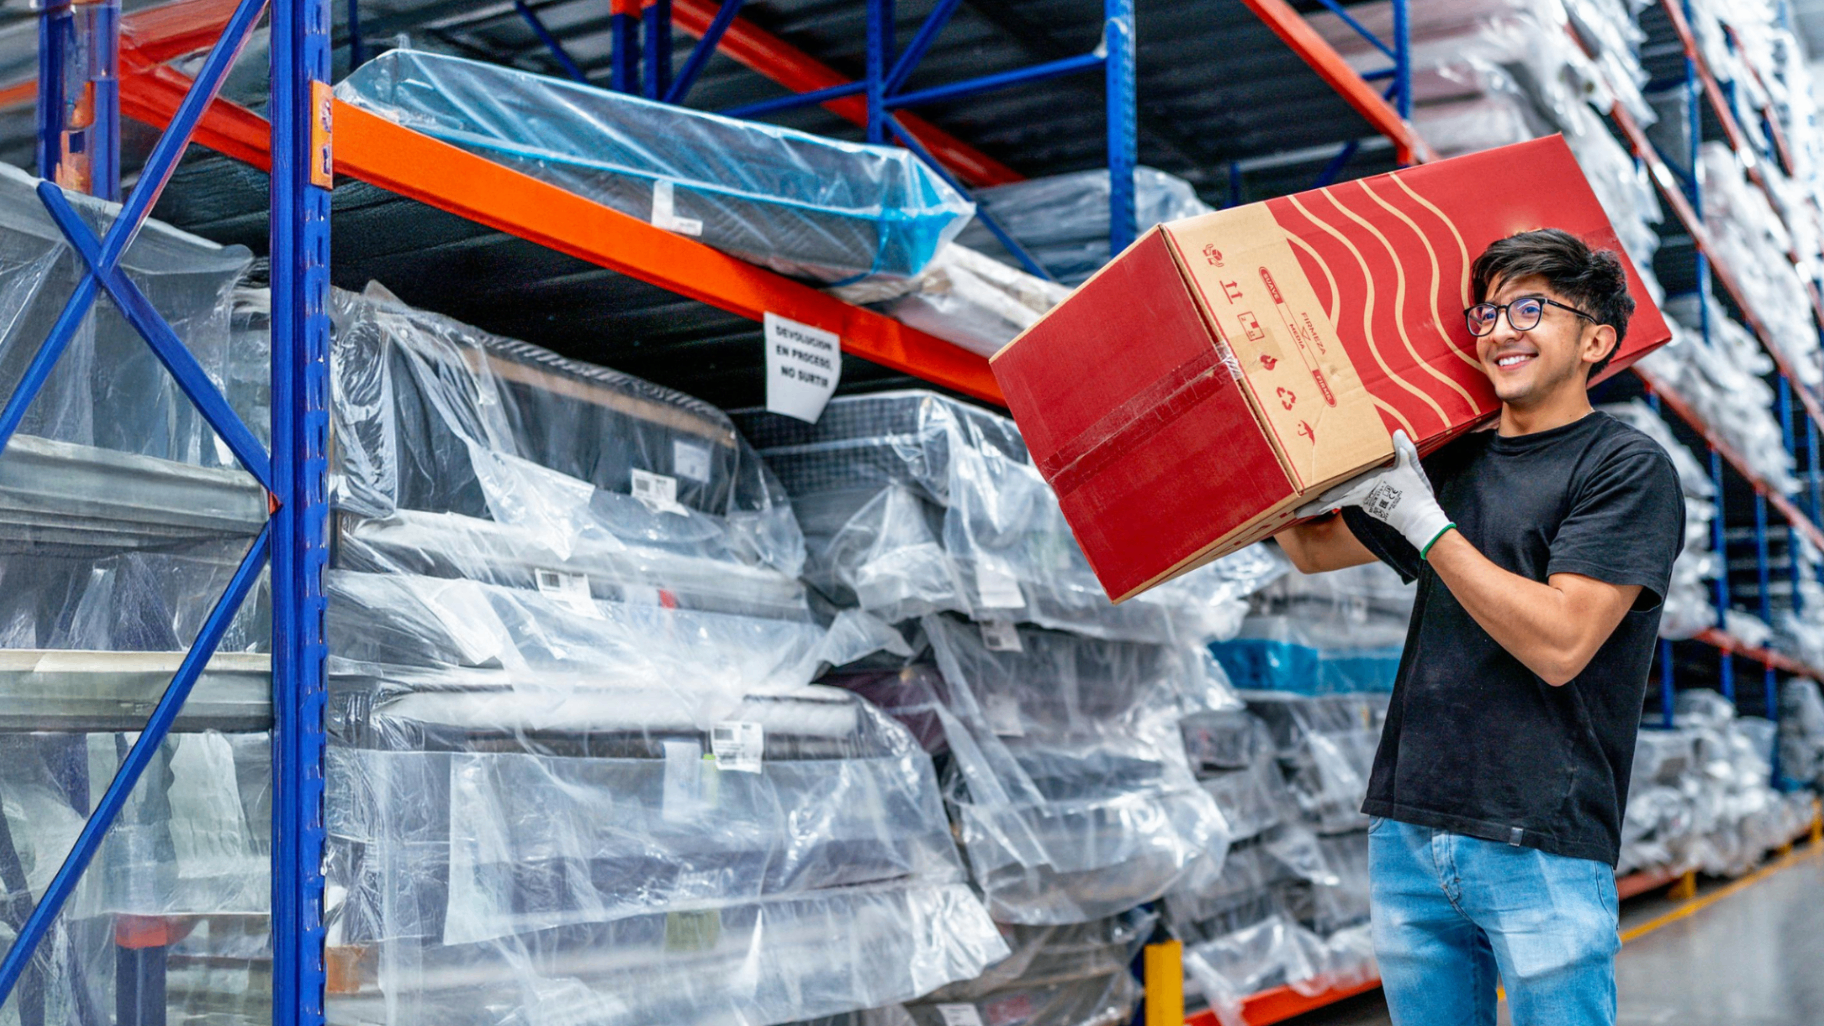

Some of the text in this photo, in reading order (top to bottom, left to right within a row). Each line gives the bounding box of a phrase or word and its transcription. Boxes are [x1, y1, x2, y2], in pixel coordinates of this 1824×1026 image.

[1263, 273, 1280, 300] SUAVE
[776, 325, 832, 350] DEVOLUCION
[1289, 323, 1305, 350] MEDIA
[1301, 312, 1326, 355] FIRMEZA
[776, 344, 789, 356] EN
[781, 366, 828, 388] NO SURTIR
[1316, 375, 1332, 401] FIRME
